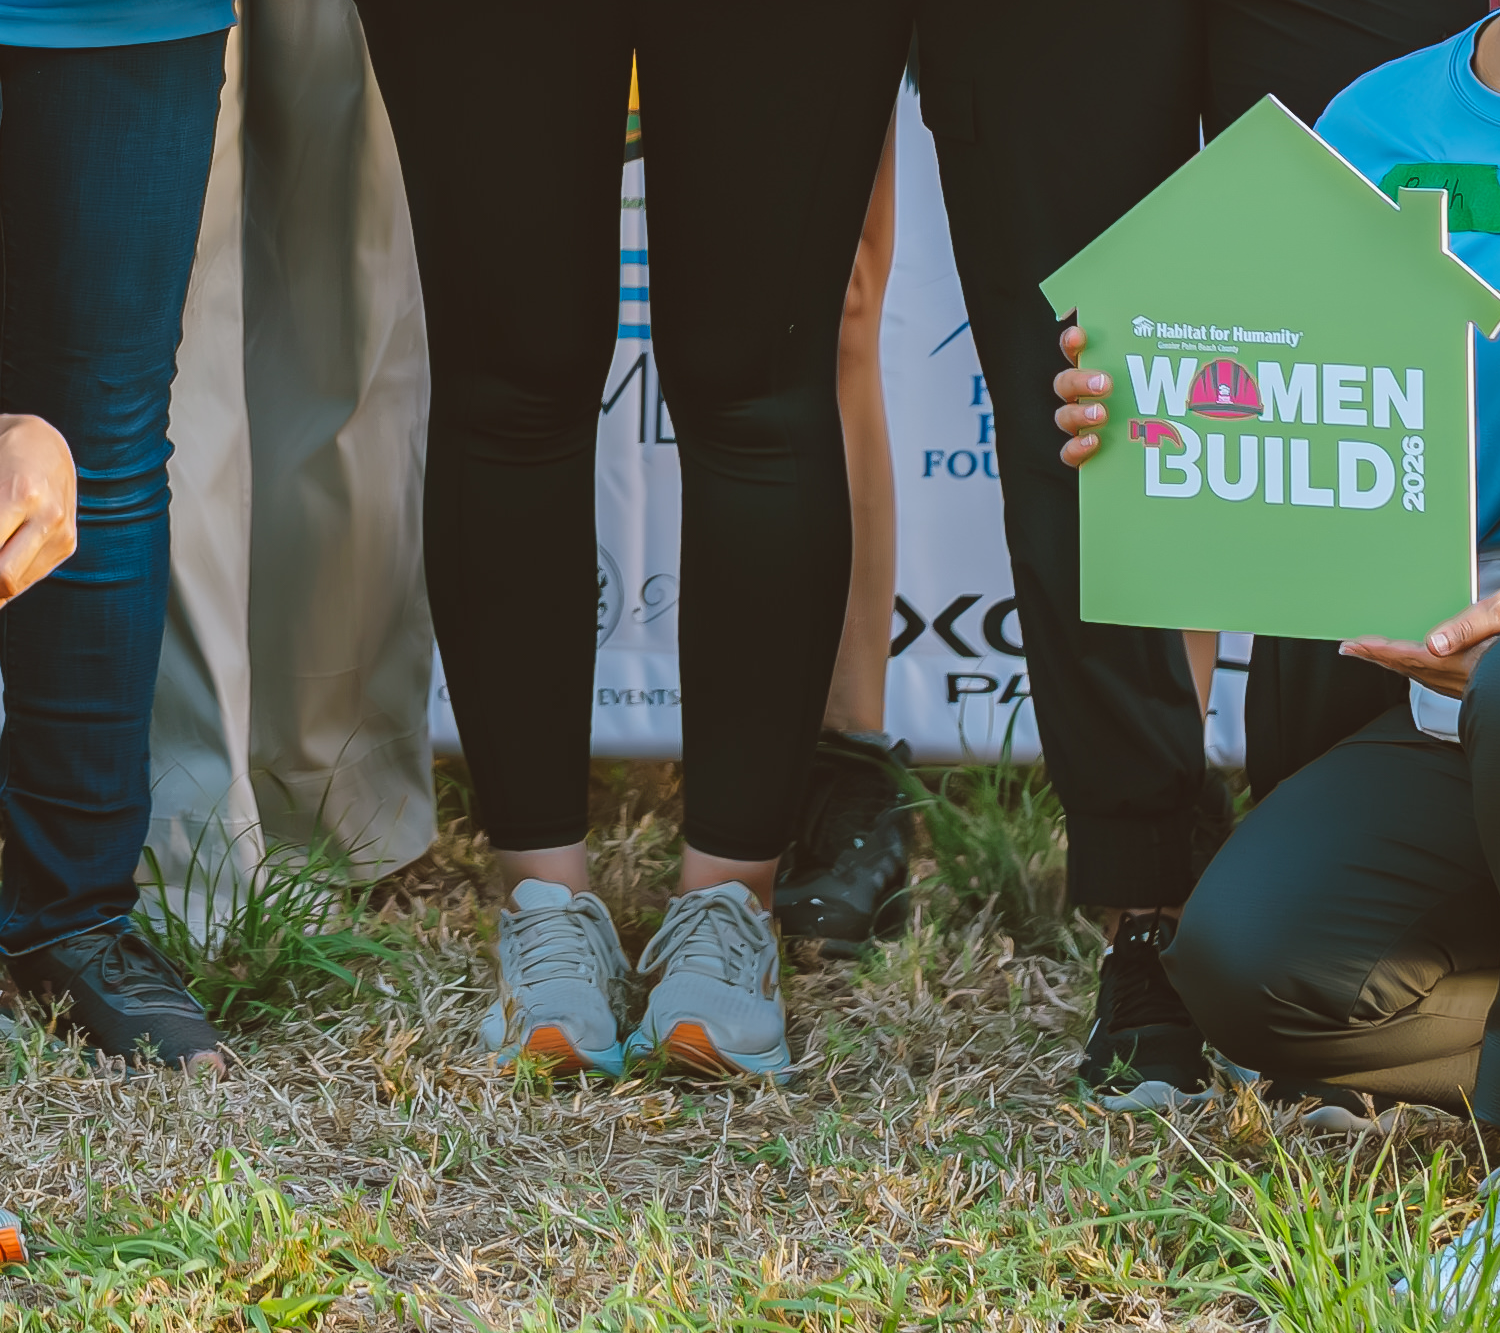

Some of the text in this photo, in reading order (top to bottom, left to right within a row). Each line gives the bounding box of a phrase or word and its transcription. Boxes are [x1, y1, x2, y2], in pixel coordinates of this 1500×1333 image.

[1156, 322, 1207, 341] Habitat
[1209, 324, 1231, 341] for
[1125, 354, 1425, 432] WOMEN
[1143, 419, 1397, 511] BUILD
[1401, 435, 1426, 512] 2026
